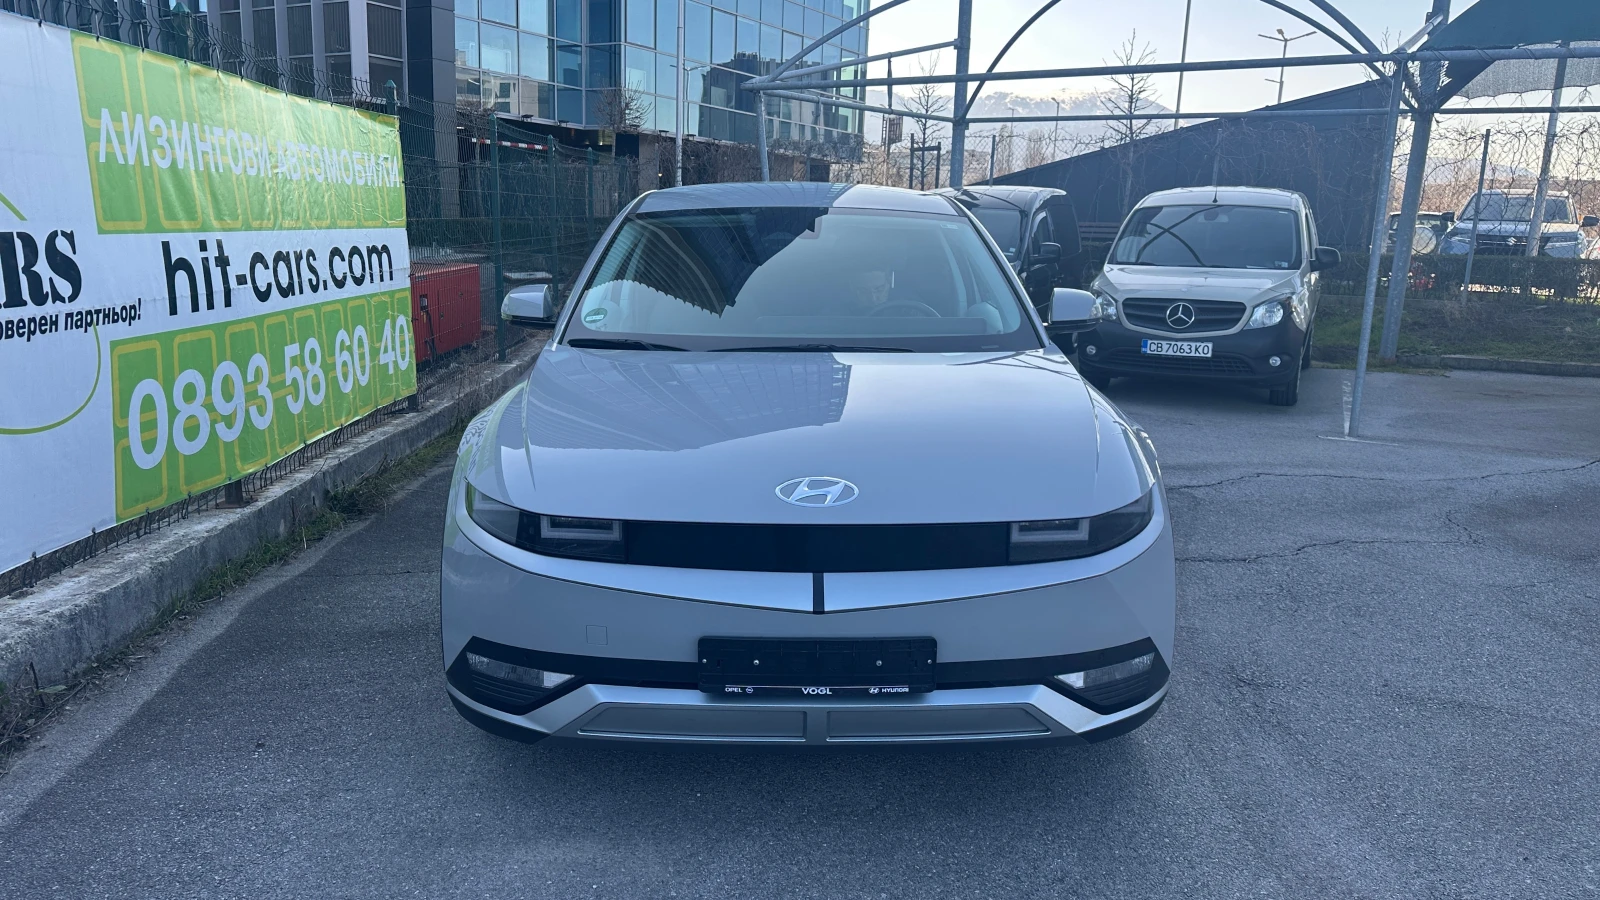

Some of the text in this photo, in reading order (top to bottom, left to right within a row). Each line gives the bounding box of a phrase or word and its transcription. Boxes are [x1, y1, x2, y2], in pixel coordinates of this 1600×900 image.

[100, 108, 272, 178] ЛИЗИНГОВИ
[0, 229, 82, 309] RS
[161, 238, 394, 317] hit-cars.com
[64, 297, 142, 334] партньор!
[1149, 342, 1210, 355] CB 7063 KO
[128, 314, 410, 470] 0893 58 60 40
[801, 687, 832, 695] VOGL
